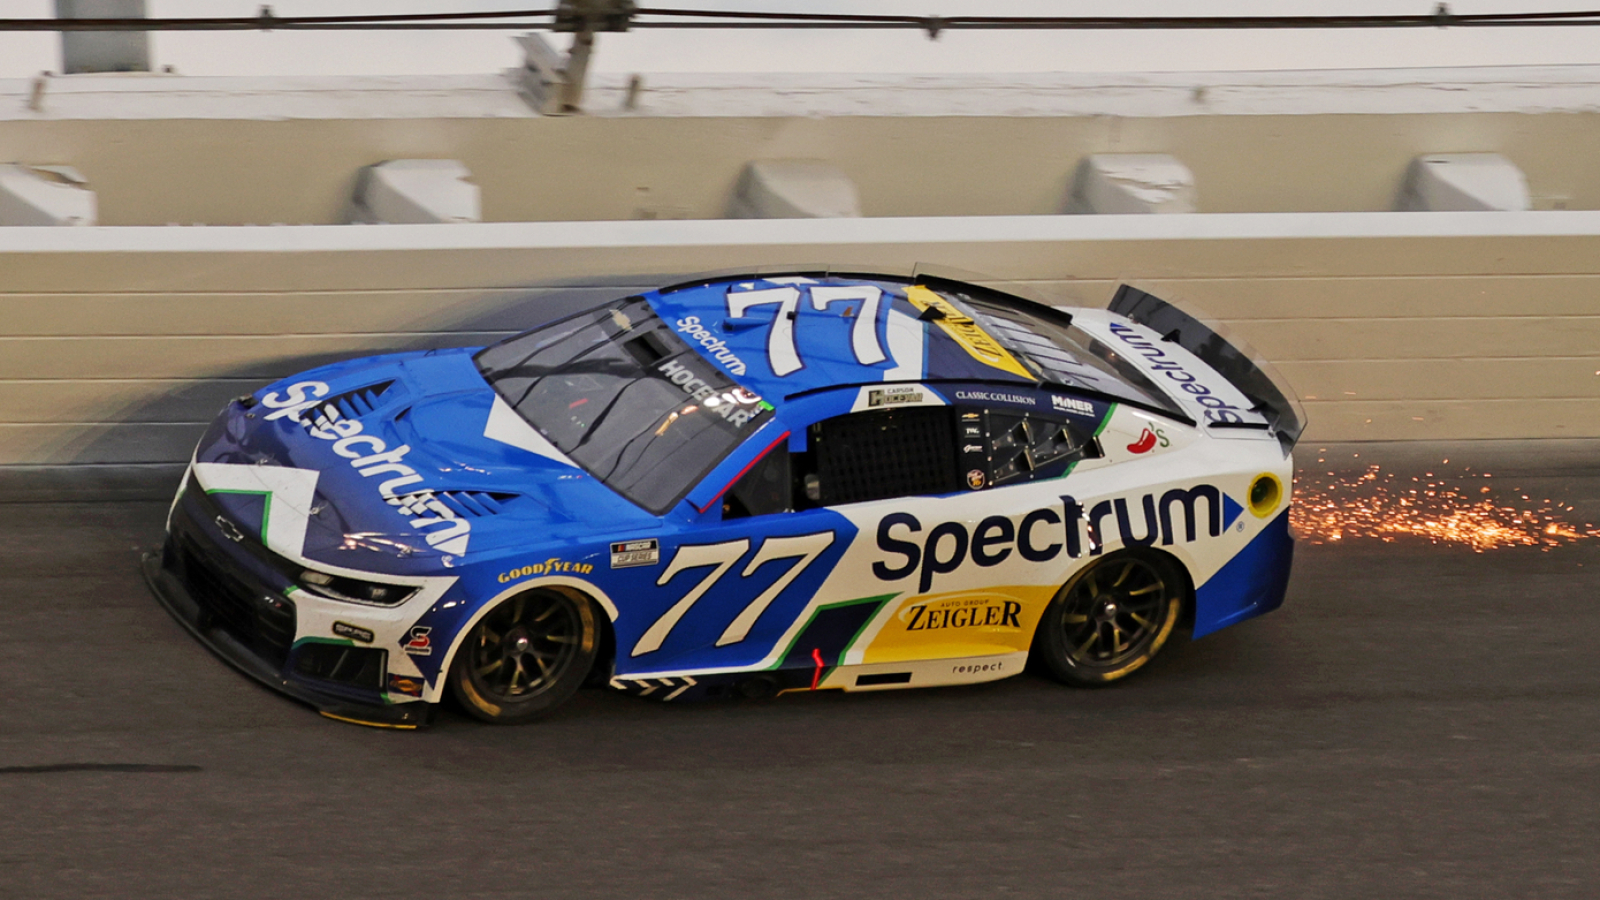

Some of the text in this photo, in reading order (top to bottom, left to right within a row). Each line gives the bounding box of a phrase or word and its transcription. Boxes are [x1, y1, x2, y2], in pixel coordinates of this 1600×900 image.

[677, 315, 745, 374] Spectrum
[726, 285, 887, 377] 77
[658, 360, 749, 428] HOCEAR
[956, 391, 1036, 405] CLASSIC COLLISION
[1110, 327, 1244, 424] Spectrum
[262, 381, 472, 547] Spectrum
[498, 558, 593, 583] GOODYEAR
[872, 484, 1221, 593] Spectrum
[630, 530, 836, 658] 77
[906, 600, 1022, 631] ZEIGLER
